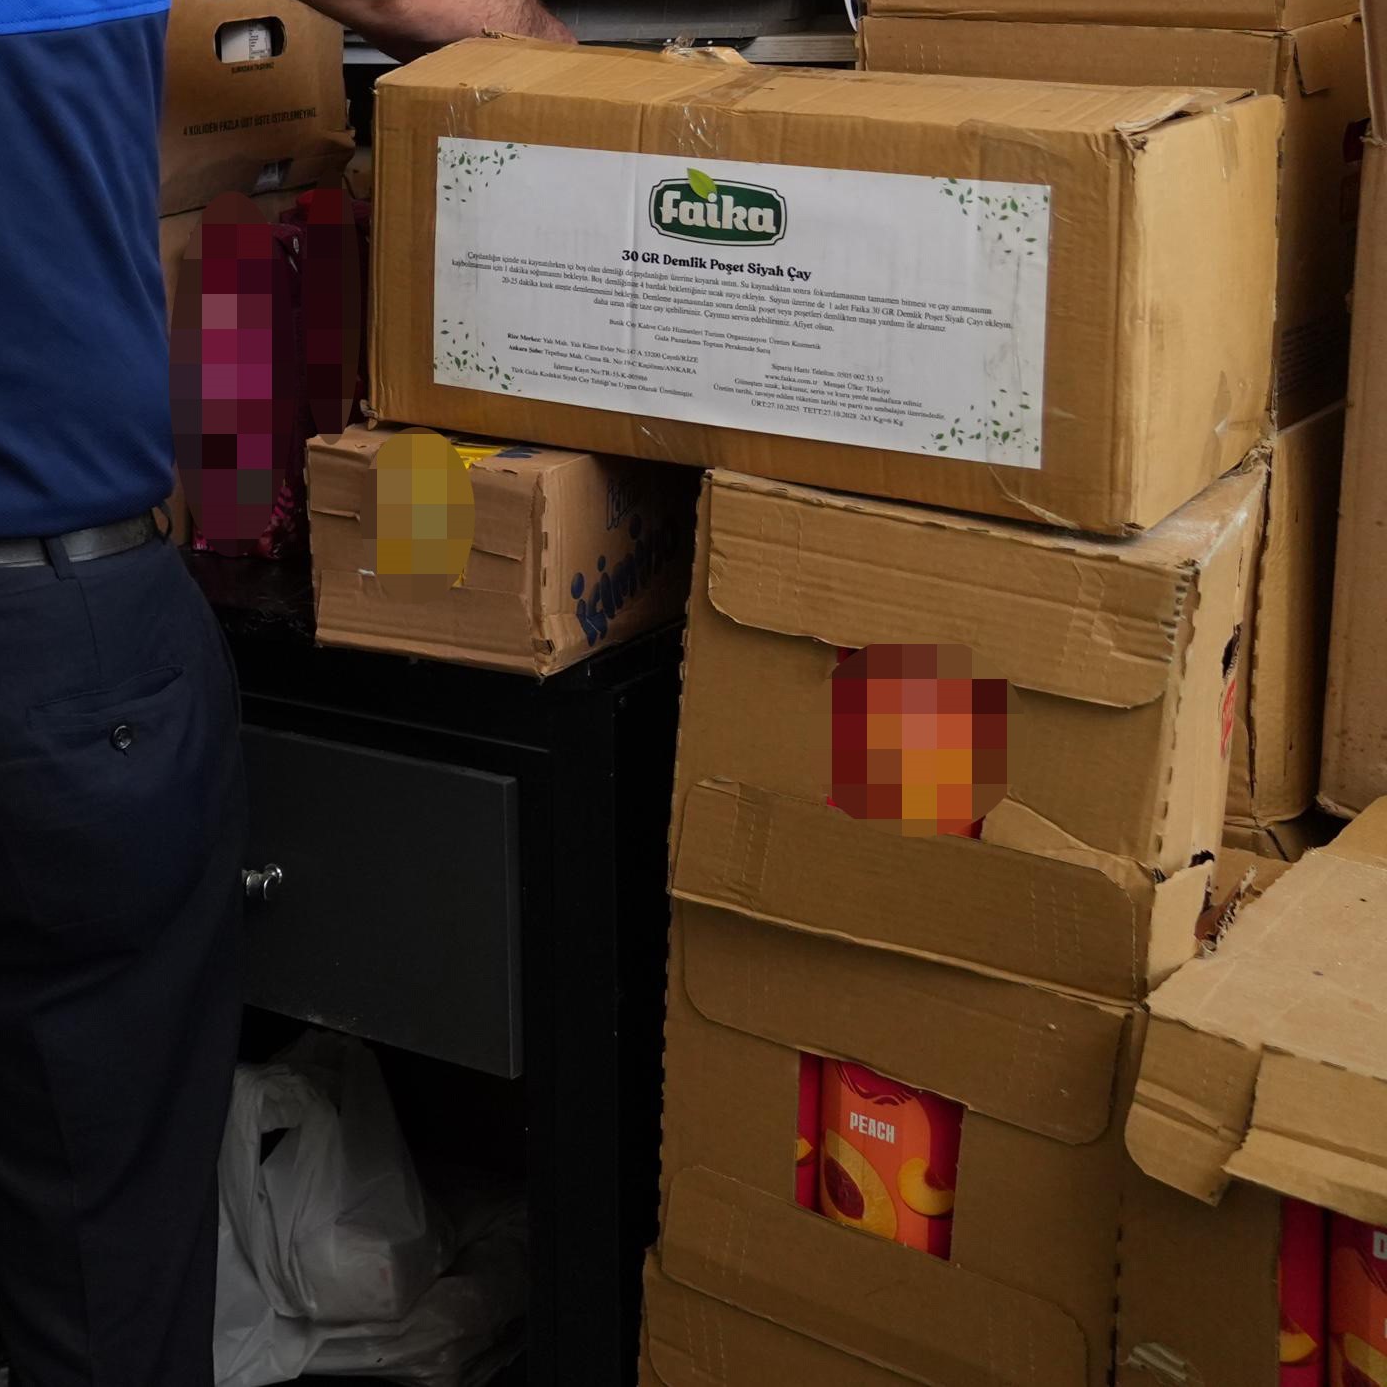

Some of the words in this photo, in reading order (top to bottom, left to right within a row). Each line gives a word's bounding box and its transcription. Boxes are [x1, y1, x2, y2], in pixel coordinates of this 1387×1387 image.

[659, 190, 777, 233] faika
[620, 248, 639, 262] 30
[640, 251, 660, 264] GR
[662, 253, 708, 269] Demlik
[709, 258, 744, 276] Poşet
[746, 261, 784, 279] Siyah
[786, 265, 812, 283] Çay
[850, 1111, 895, 1144] PEACH
